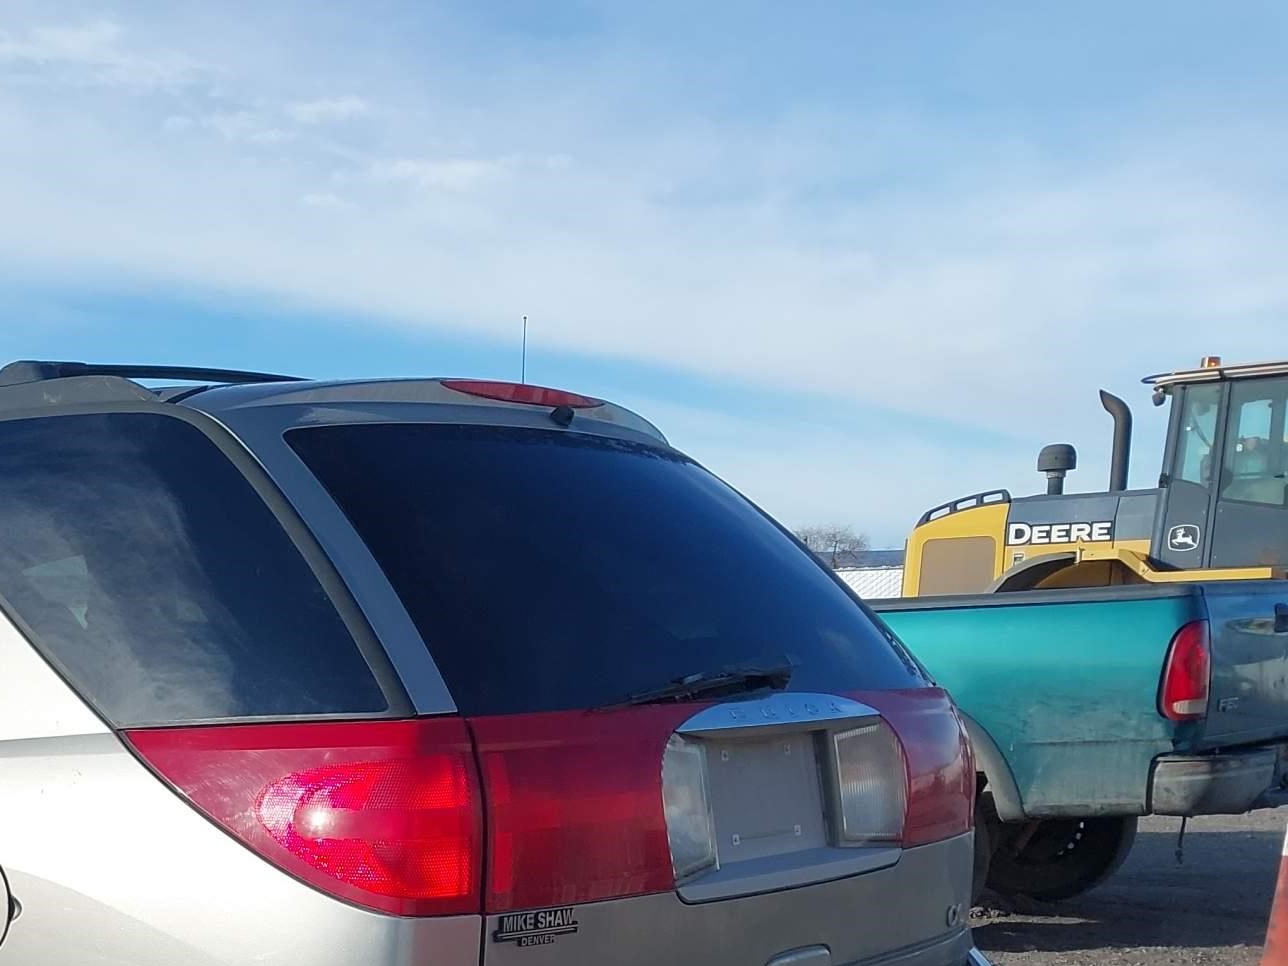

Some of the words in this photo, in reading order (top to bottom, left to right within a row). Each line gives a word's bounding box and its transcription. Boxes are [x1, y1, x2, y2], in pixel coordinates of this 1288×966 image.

[1008, 522, 1112, 545] DEERE
[503, 913, 534, 933] MIKE
[537, 908, 575, 929] SHAW
[521, 935, 556, 947] DENVER
